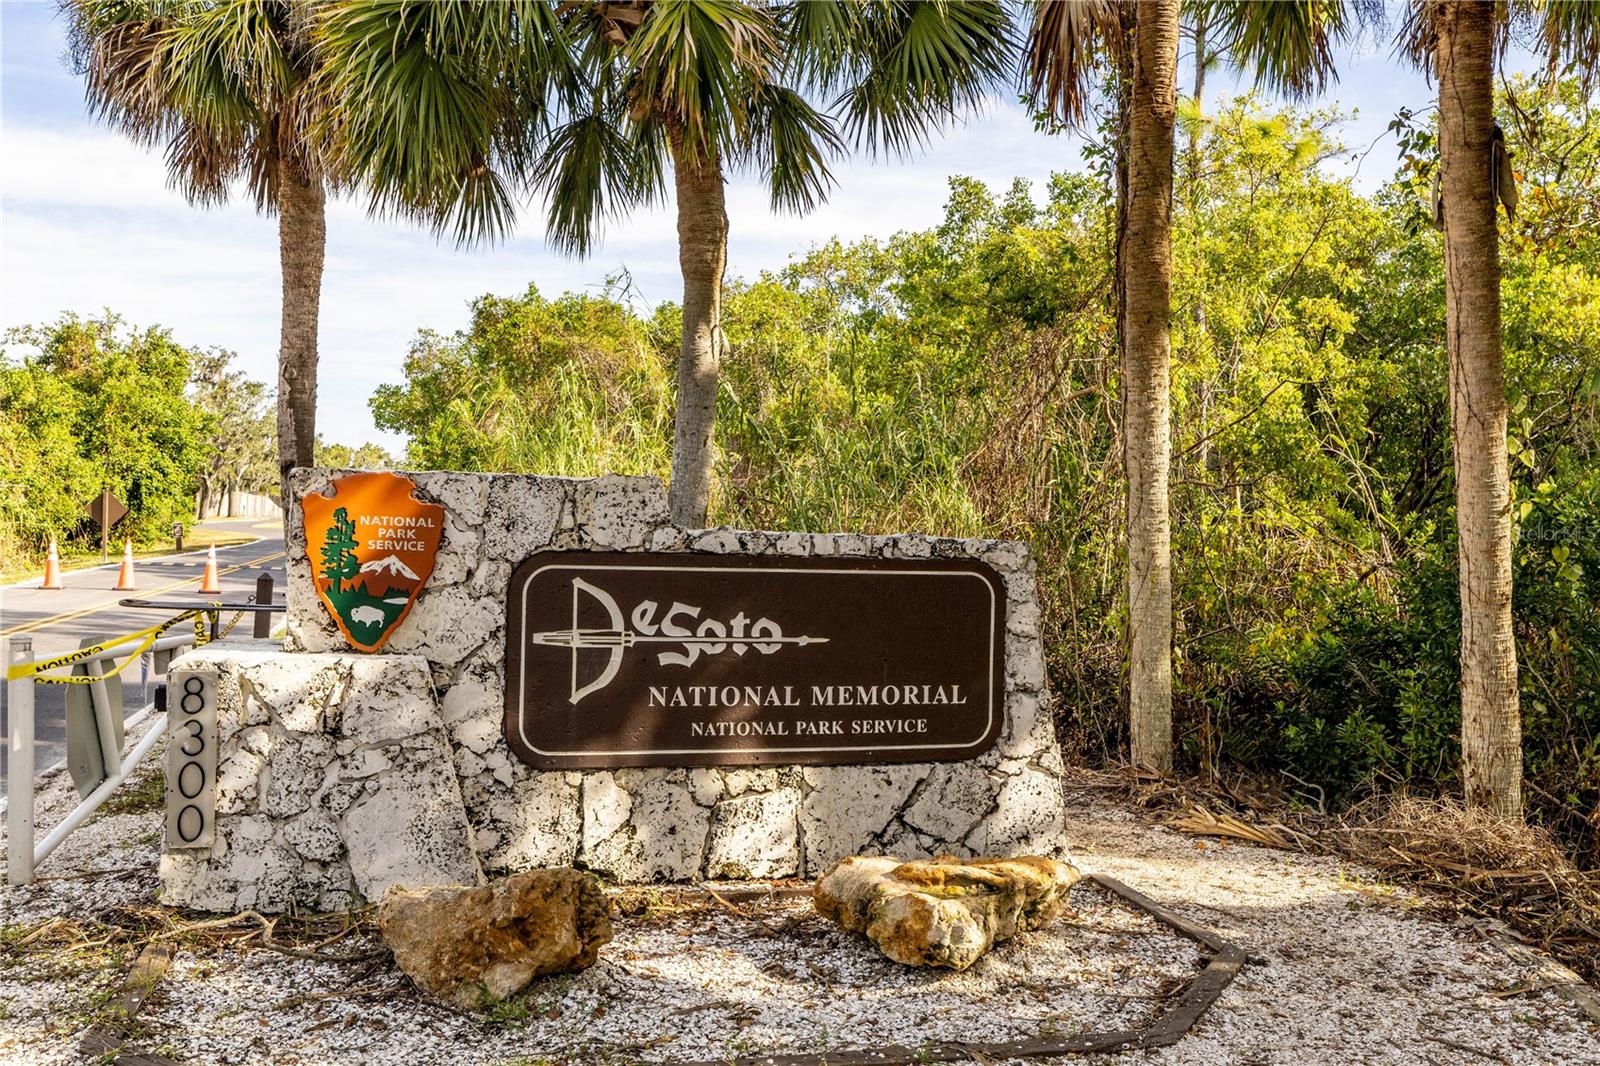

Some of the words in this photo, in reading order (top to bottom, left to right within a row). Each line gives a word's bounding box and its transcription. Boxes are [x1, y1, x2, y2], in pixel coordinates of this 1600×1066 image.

[360, 515, 435, 528] NATIONAL
[378, 528, 416, 539] PARK
[367, 540, 425, 551] SERVICE
[648, 686, 801, 707] NATIONAL
[811, 684, 967, 706] MEMORIAL
[691, 721, 789, 737] NATIONAL
[796, 720, 844, 735] PARK
[851, 719, 928, 734] SERVICE
[178, 677, 206, 843] 8300
